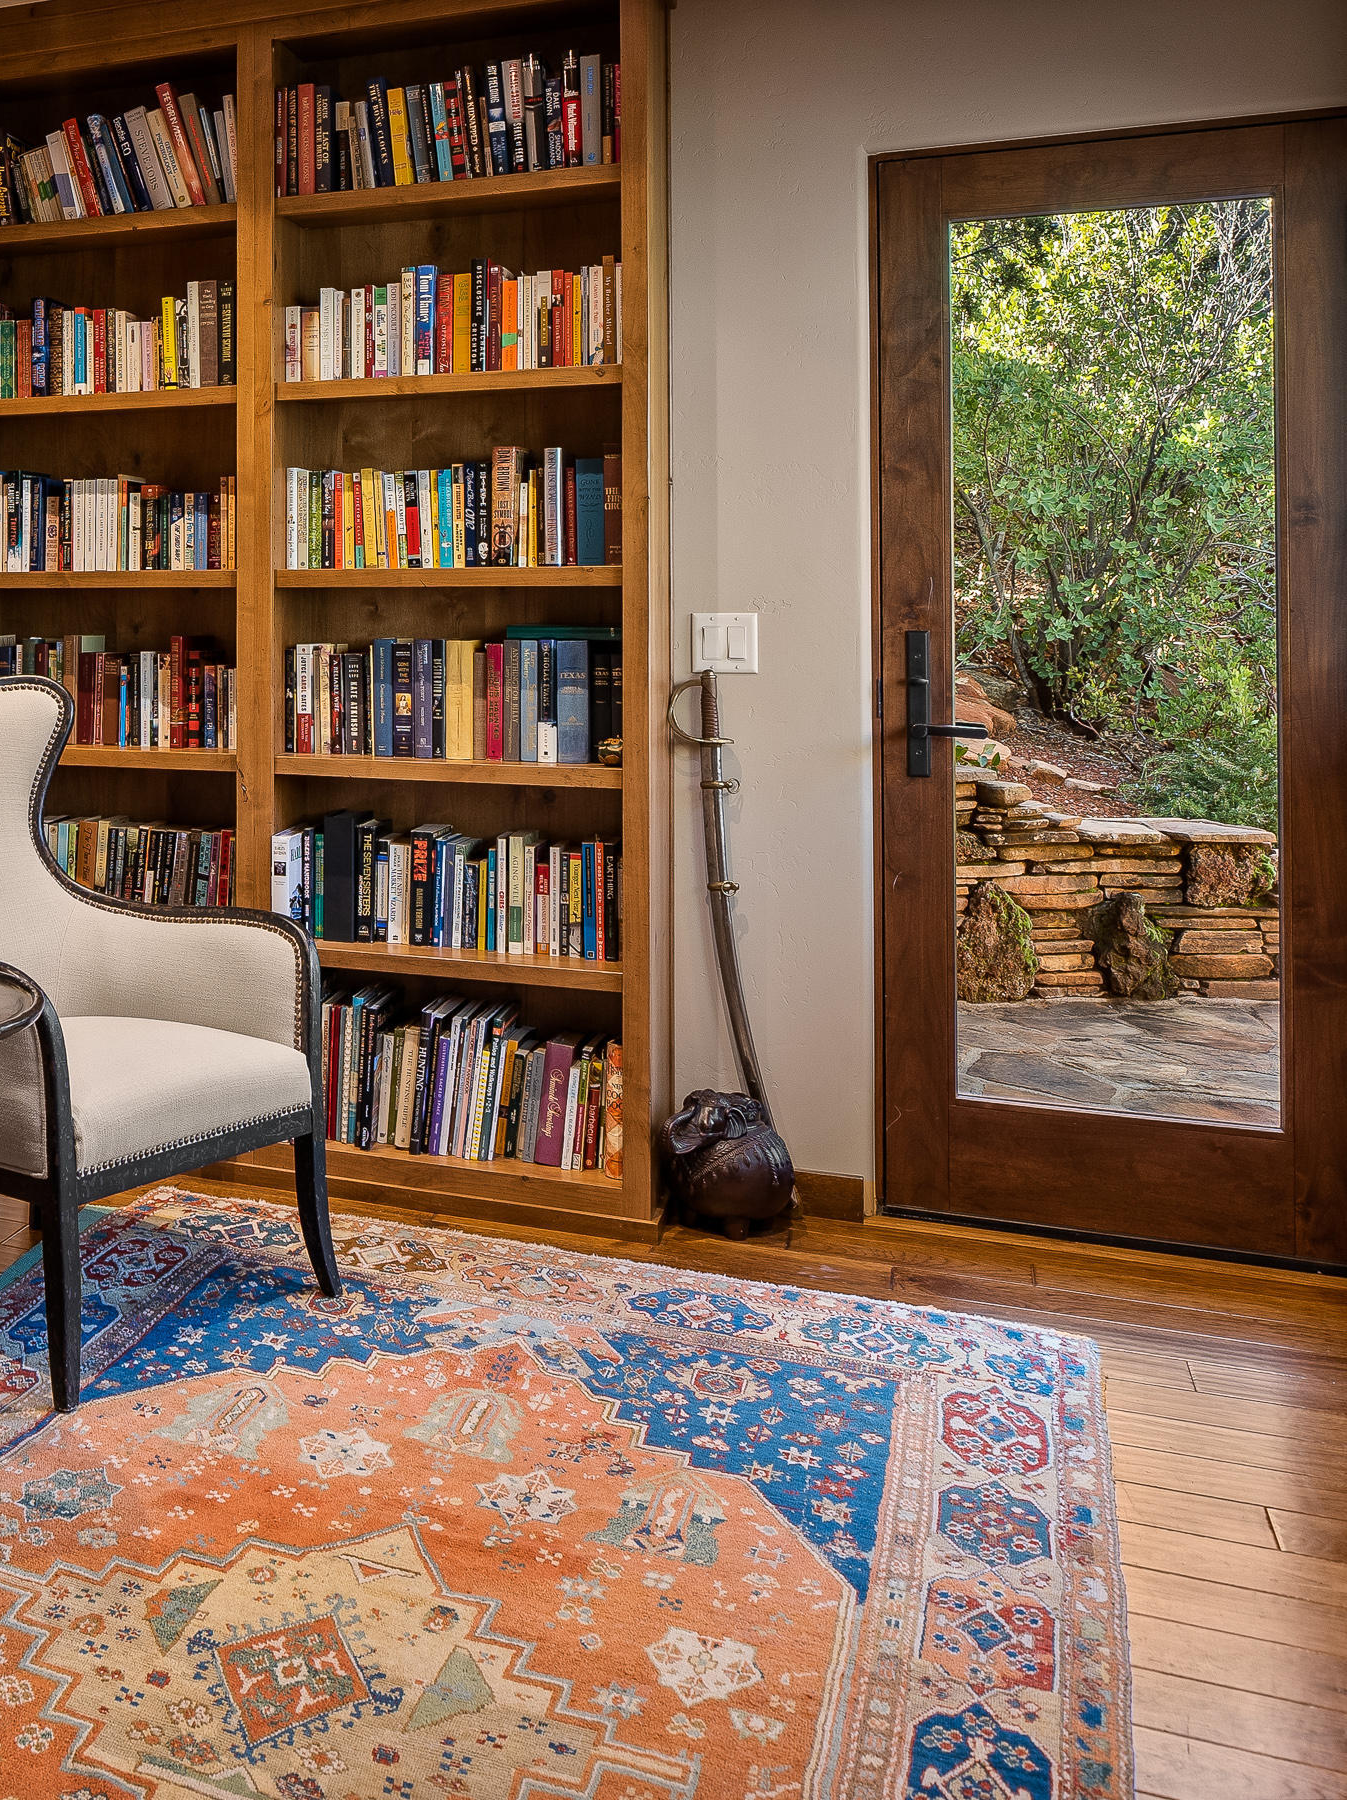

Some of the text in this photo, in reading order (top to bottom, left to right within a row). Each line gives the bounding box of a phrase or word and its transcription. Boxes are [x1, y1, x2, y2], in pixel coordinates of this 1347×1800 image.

[368, 84, 389, 164] THE BONE CLOCKS
[467, 101, 478, 145] KIDNAPPED
[135, 129, 159, 191] STEVE JOBS
[322, 152, 329, 163] OF
[417, 273, 433, 323] Tom Clancy
[475, 265, 483, 317] DISCLOSURE
[497, 449, 511, 492] DAN BROWN
[350, 681, 358, 736] KATE ATKINSON
[362, 834, 372, 916] THE SEVEN SISTERS
[413, 839, 427, 882] PRIZE
[415, 1047, 427, 1090] HUNTING
[586, 1105, 597, 1144] barbecue
